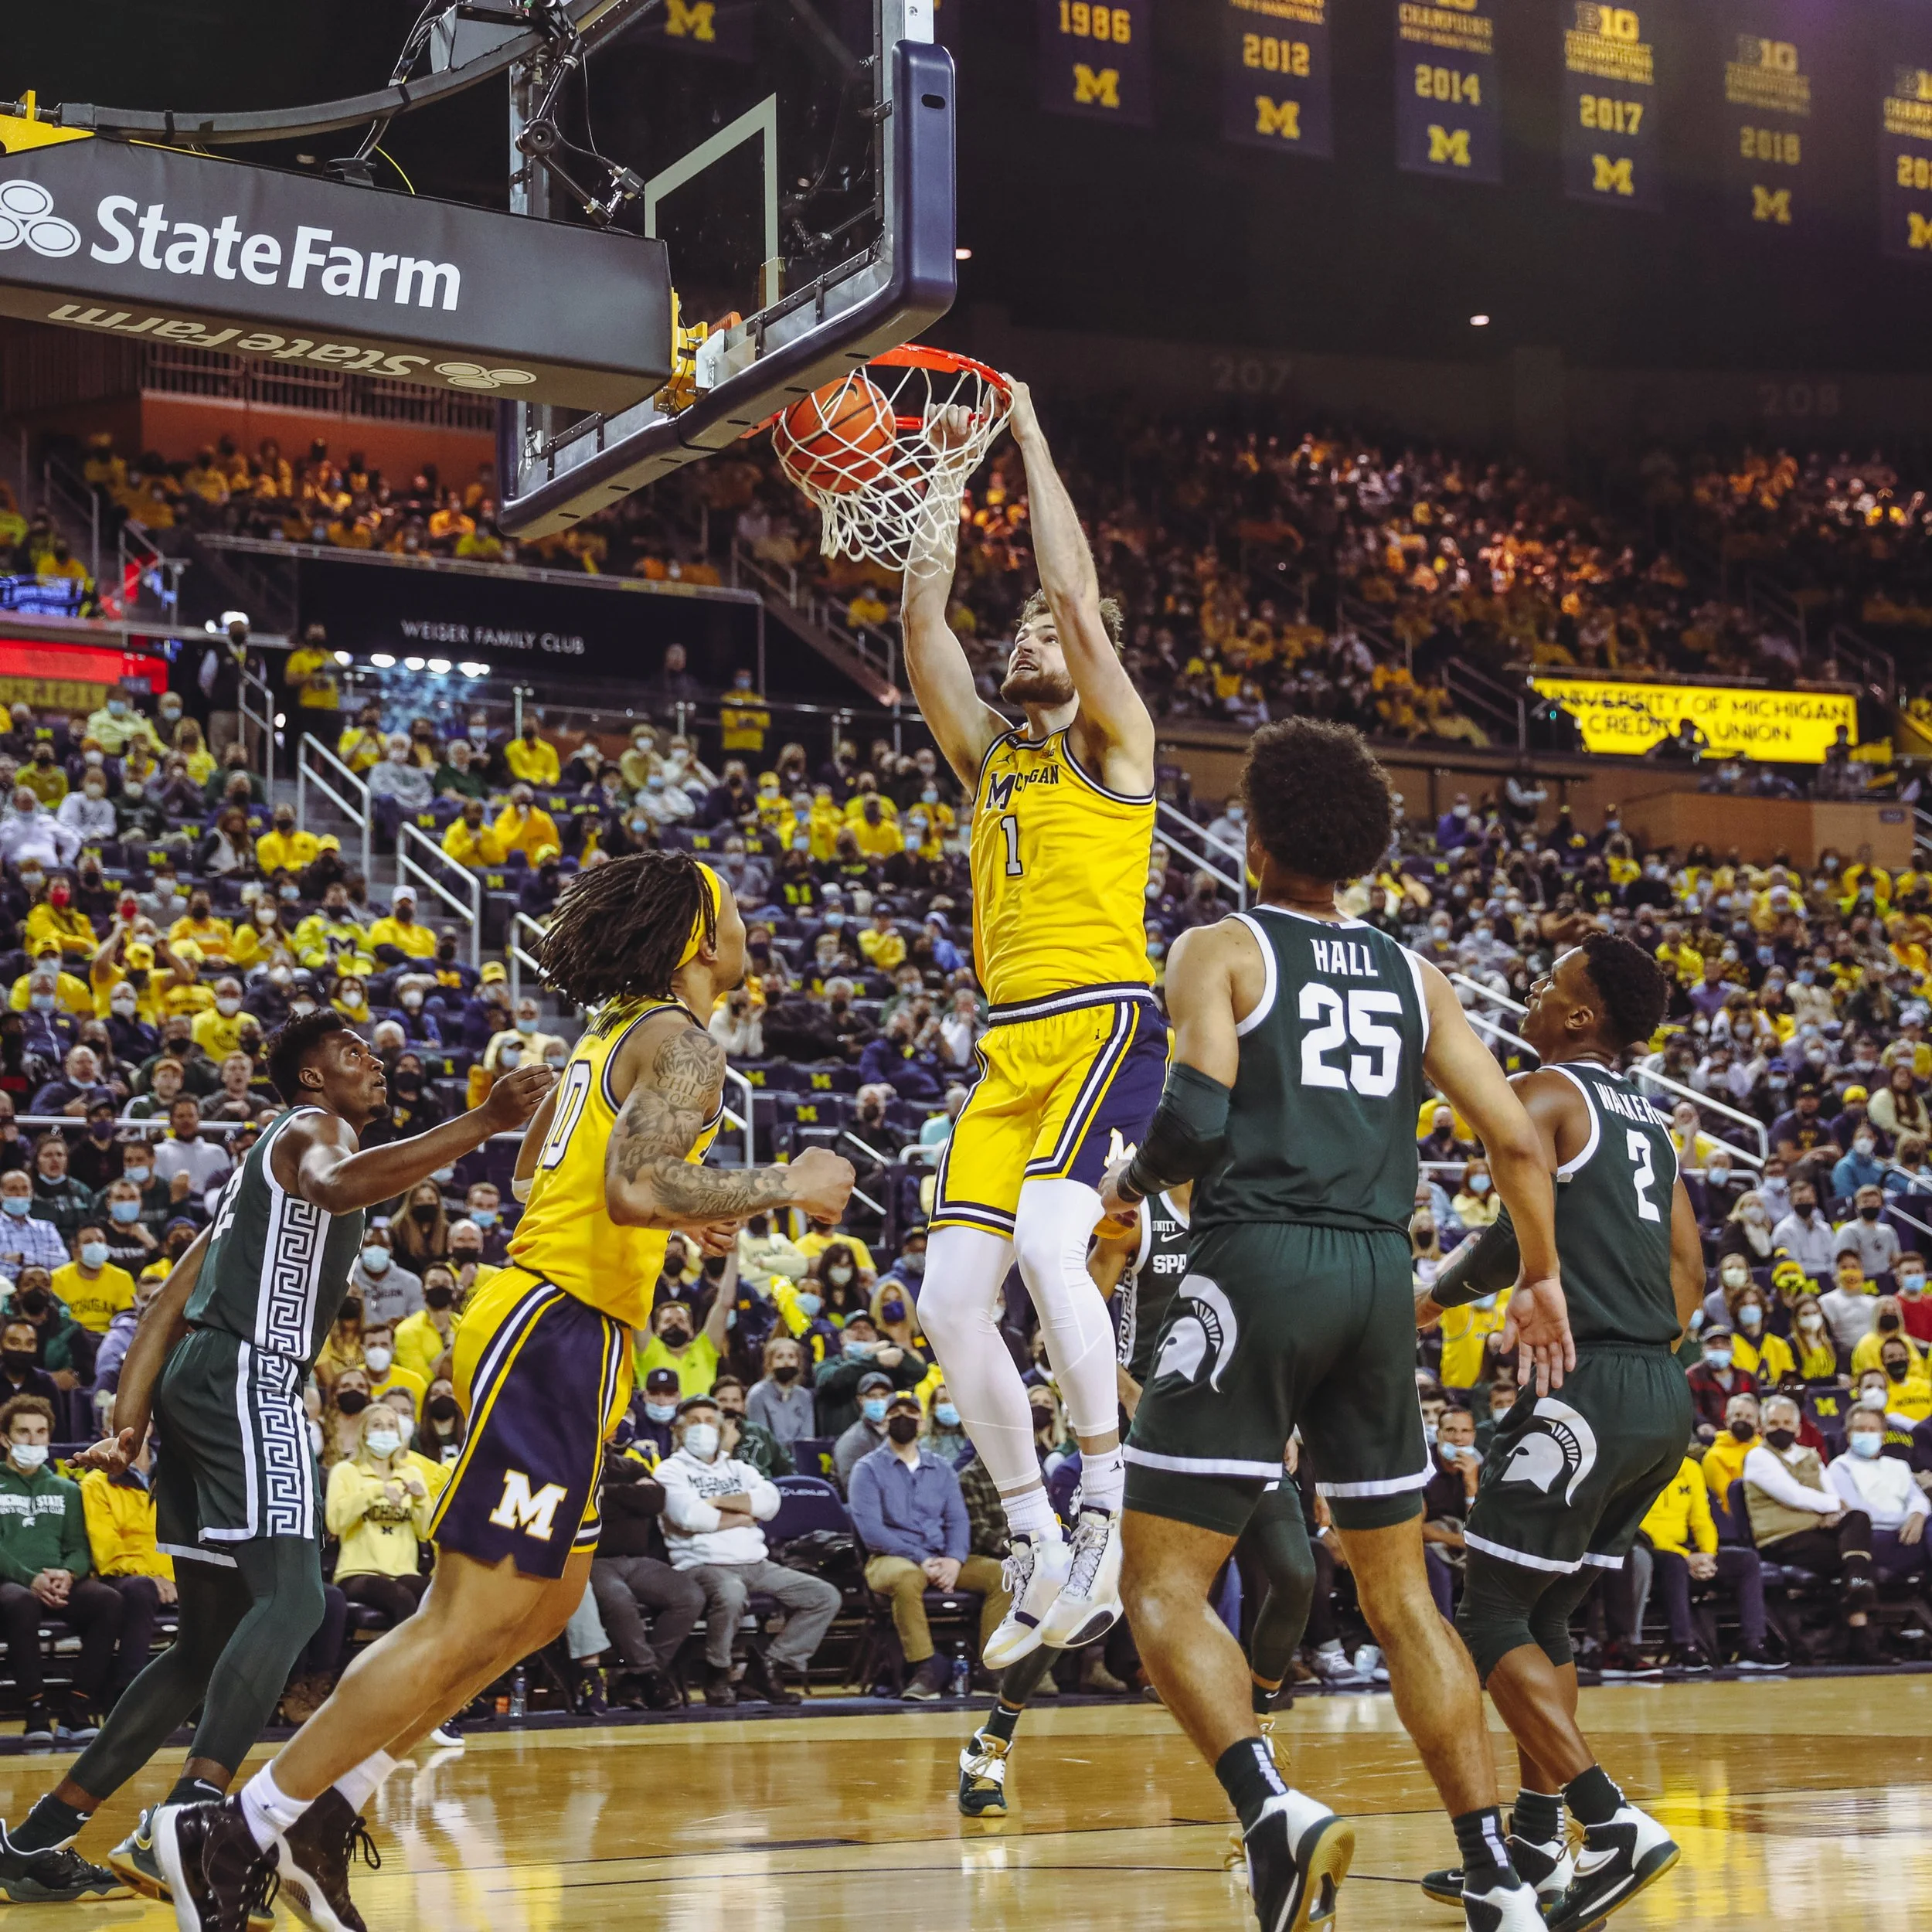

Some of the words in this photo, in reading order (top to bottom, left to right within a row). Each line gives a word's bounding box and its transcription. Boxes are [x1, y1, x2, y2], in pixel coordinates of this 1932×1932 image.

[1061, 0, 1131, 43] 1986
[1244, 35, 1309, 74] 2012
[1076, 66, 1118, 106] M
[1417, 65, 1480, 104] 2014
[1257, 98, 1298, 137] M
[1581, 95, 1642, 133] 2017
[1430, 127, 1470, 165] M
[1594, 155, 1632, 193] M
[1753, 186, 1790, 223] M
[1209, 355, 1294, 394] 207
[401, 620, 469, 643] WEISER
[474, 626, 536, 649] FAMILY
[540, 632, 585, 655] CLUB
[1692, 695, 1720, 714] OF
[1731, 696, 1849, 722] MICHIGAN
[1714, 721, 1792, 741] UNION
[1000, 815, 1024, 877] 1
[328, 936, 357, 957] M
[1309, 938, 1379, 977] HALL
[1298, 981, 1403, 1097] 25
[657, 1074, 709, 1105] CHILD
[670, 1092, 690, 1106] OF
[1626, 1128, 1661, 1223] 2
[489, 1468, 568, 1542] M
